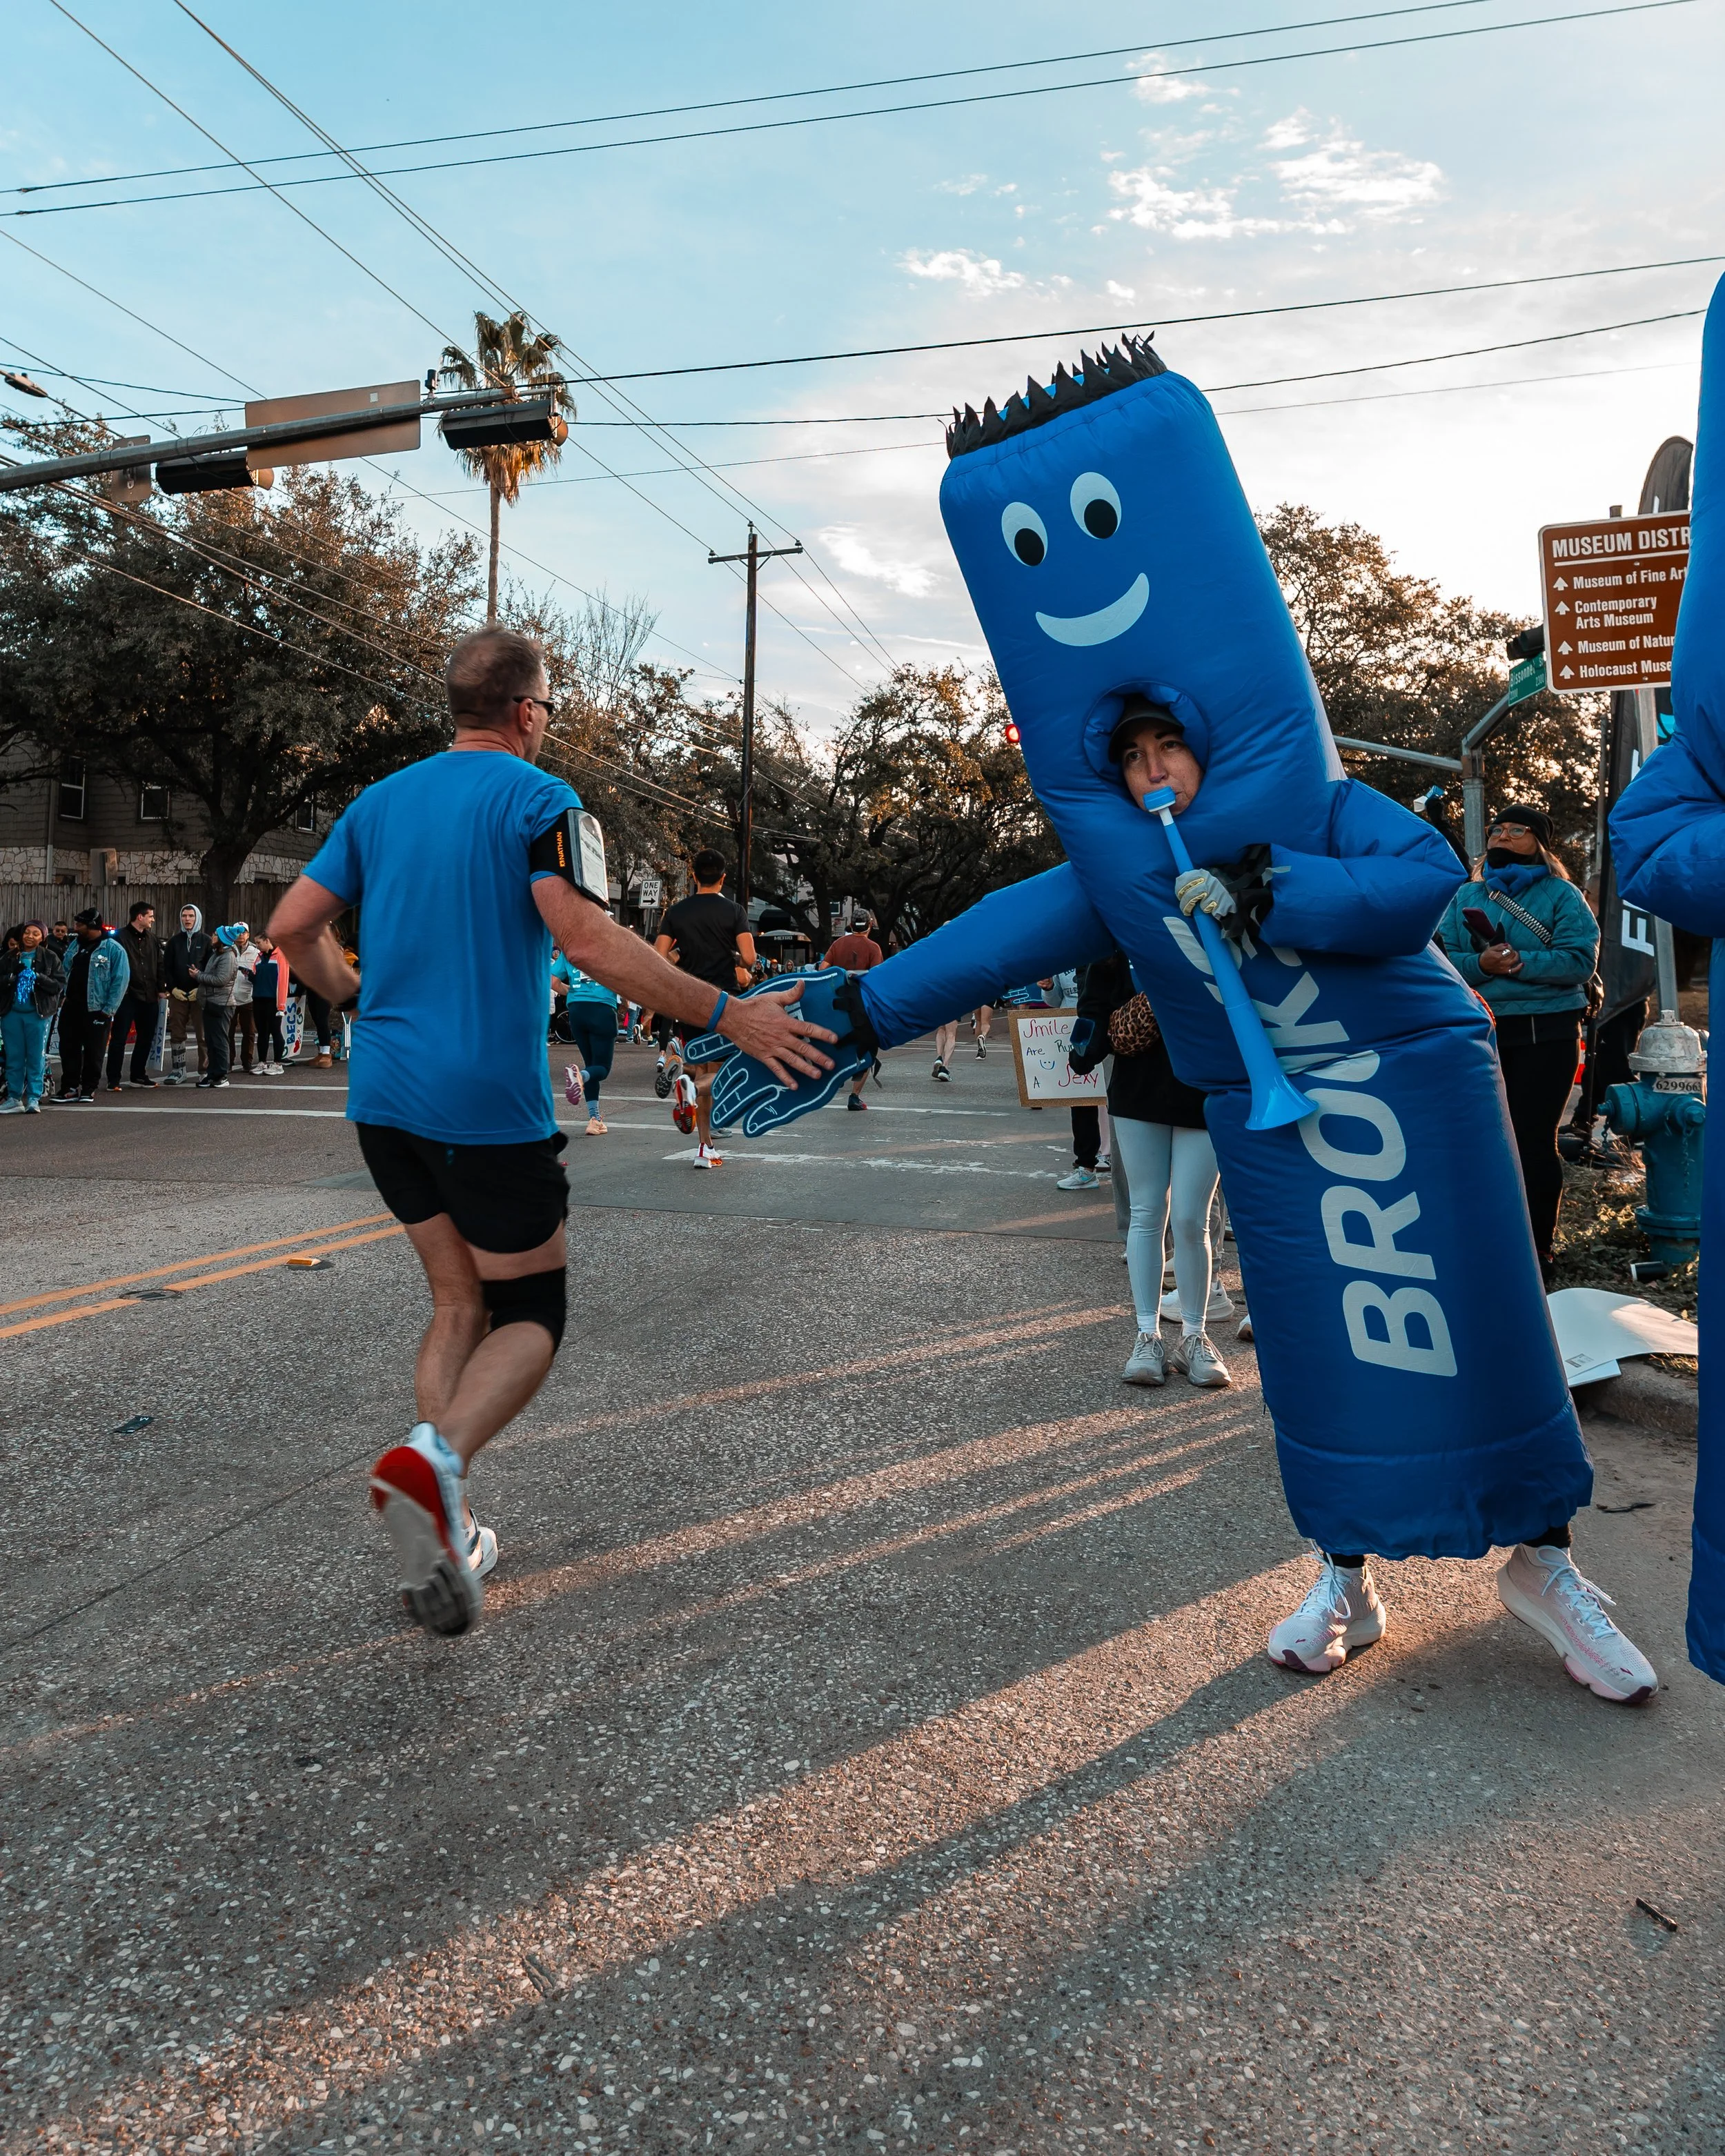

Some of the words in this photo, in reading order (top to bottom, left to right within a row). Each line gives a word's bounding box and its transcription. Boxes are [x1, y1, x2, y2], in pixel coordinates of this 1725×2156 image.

[1552, 532, 1632, 558] MUSEUM
[1573, 575, 1622, 589] Museum
[1626, 571, 1637, 584] of
[1641, 570, 1666, 583] Fine
[1575, 596, 1657, 613] Contemporary
[1576, 616, 1600, 629] Arts
[1604, 613, 1654, 627] Museum
[1578, 640, 1626, 653] Museum
[1629, 636, 1640, 649] of
[1579, 662, 1638, 678] Holocaust
[556, 831, 564, 859] NATHAN
[1026, 1047, 1045, 1056] Are
[1034, 1076, 1041, 1089] A
[1058, 1063, 1098, 1089] Sexy
